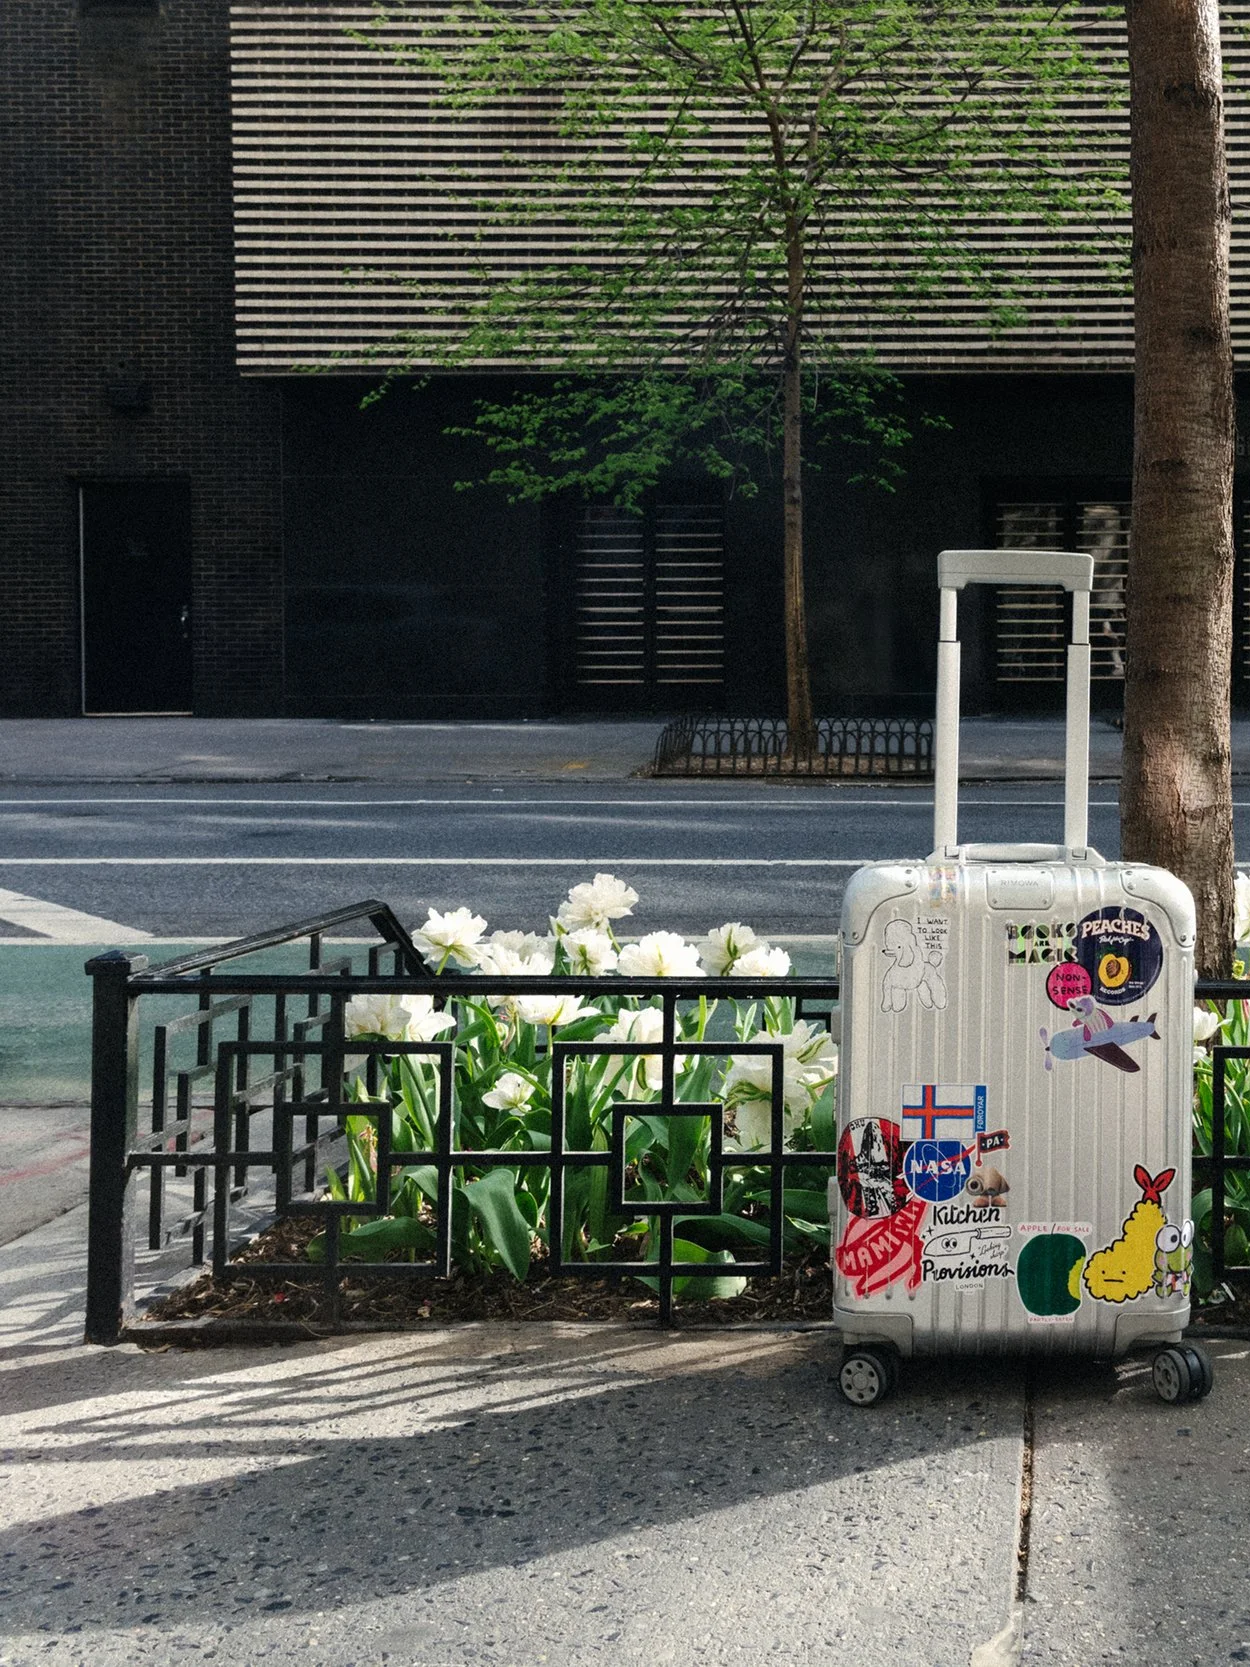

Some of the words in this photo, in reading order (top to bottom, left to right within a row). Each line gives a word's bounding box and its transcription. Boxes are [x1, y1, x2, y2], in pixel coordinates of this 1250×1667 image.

[1000, 879, 1039, 888] RIMOWA
[917, 926, 928, 934] TO
[1006, 922, 1077, 940] BOOKS
[1081, 918, 1151, 942] PEACHES
[925, 942, 942, 950] THIS
[1056, 973, 1086, 982] NON-
[1052, 985, 1088, 996] SENSE
[910, 1159, 967, 1175] NASA
[933, 1204, 1001, 1226] Kitchen
[1020, 1224, 1048, 1232] APPLE
[922, 1259, 1015, 1282] Provisions
